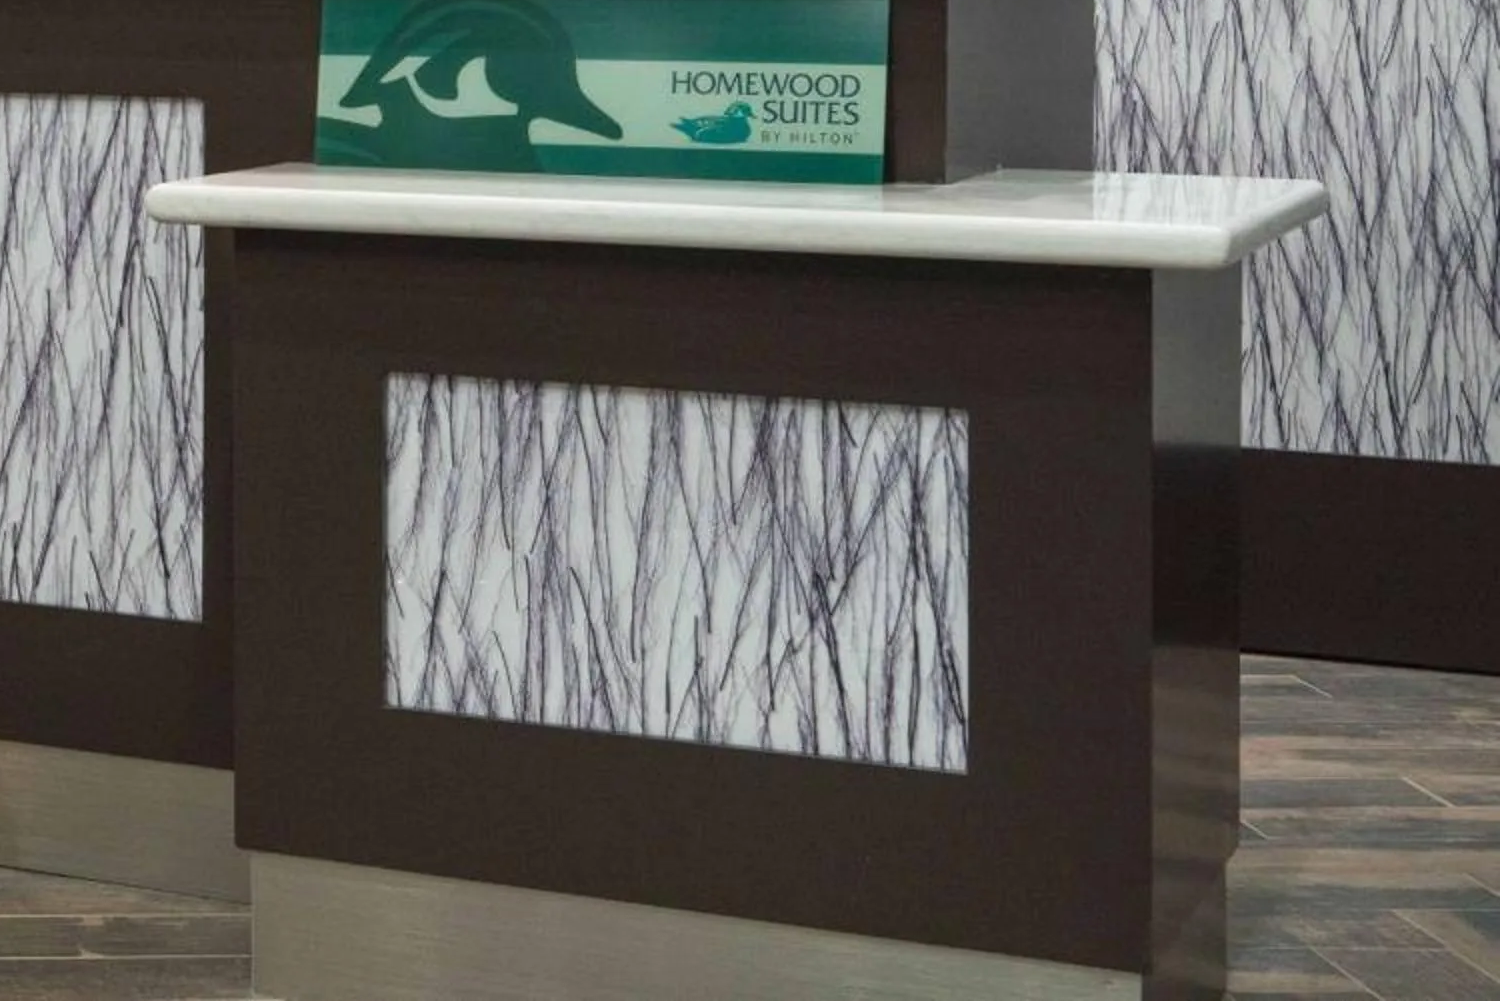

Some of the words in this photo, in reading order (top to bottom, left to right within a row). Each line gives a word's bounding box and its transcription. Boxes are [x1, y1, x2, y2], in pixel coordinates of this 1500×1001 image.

[671, 71, 861, 98] HOMEWOOD
[762, 100, 860, 126] SUITES
[761, 130, 780, 144] BY
[789, 131, 853, 146] HILTON
